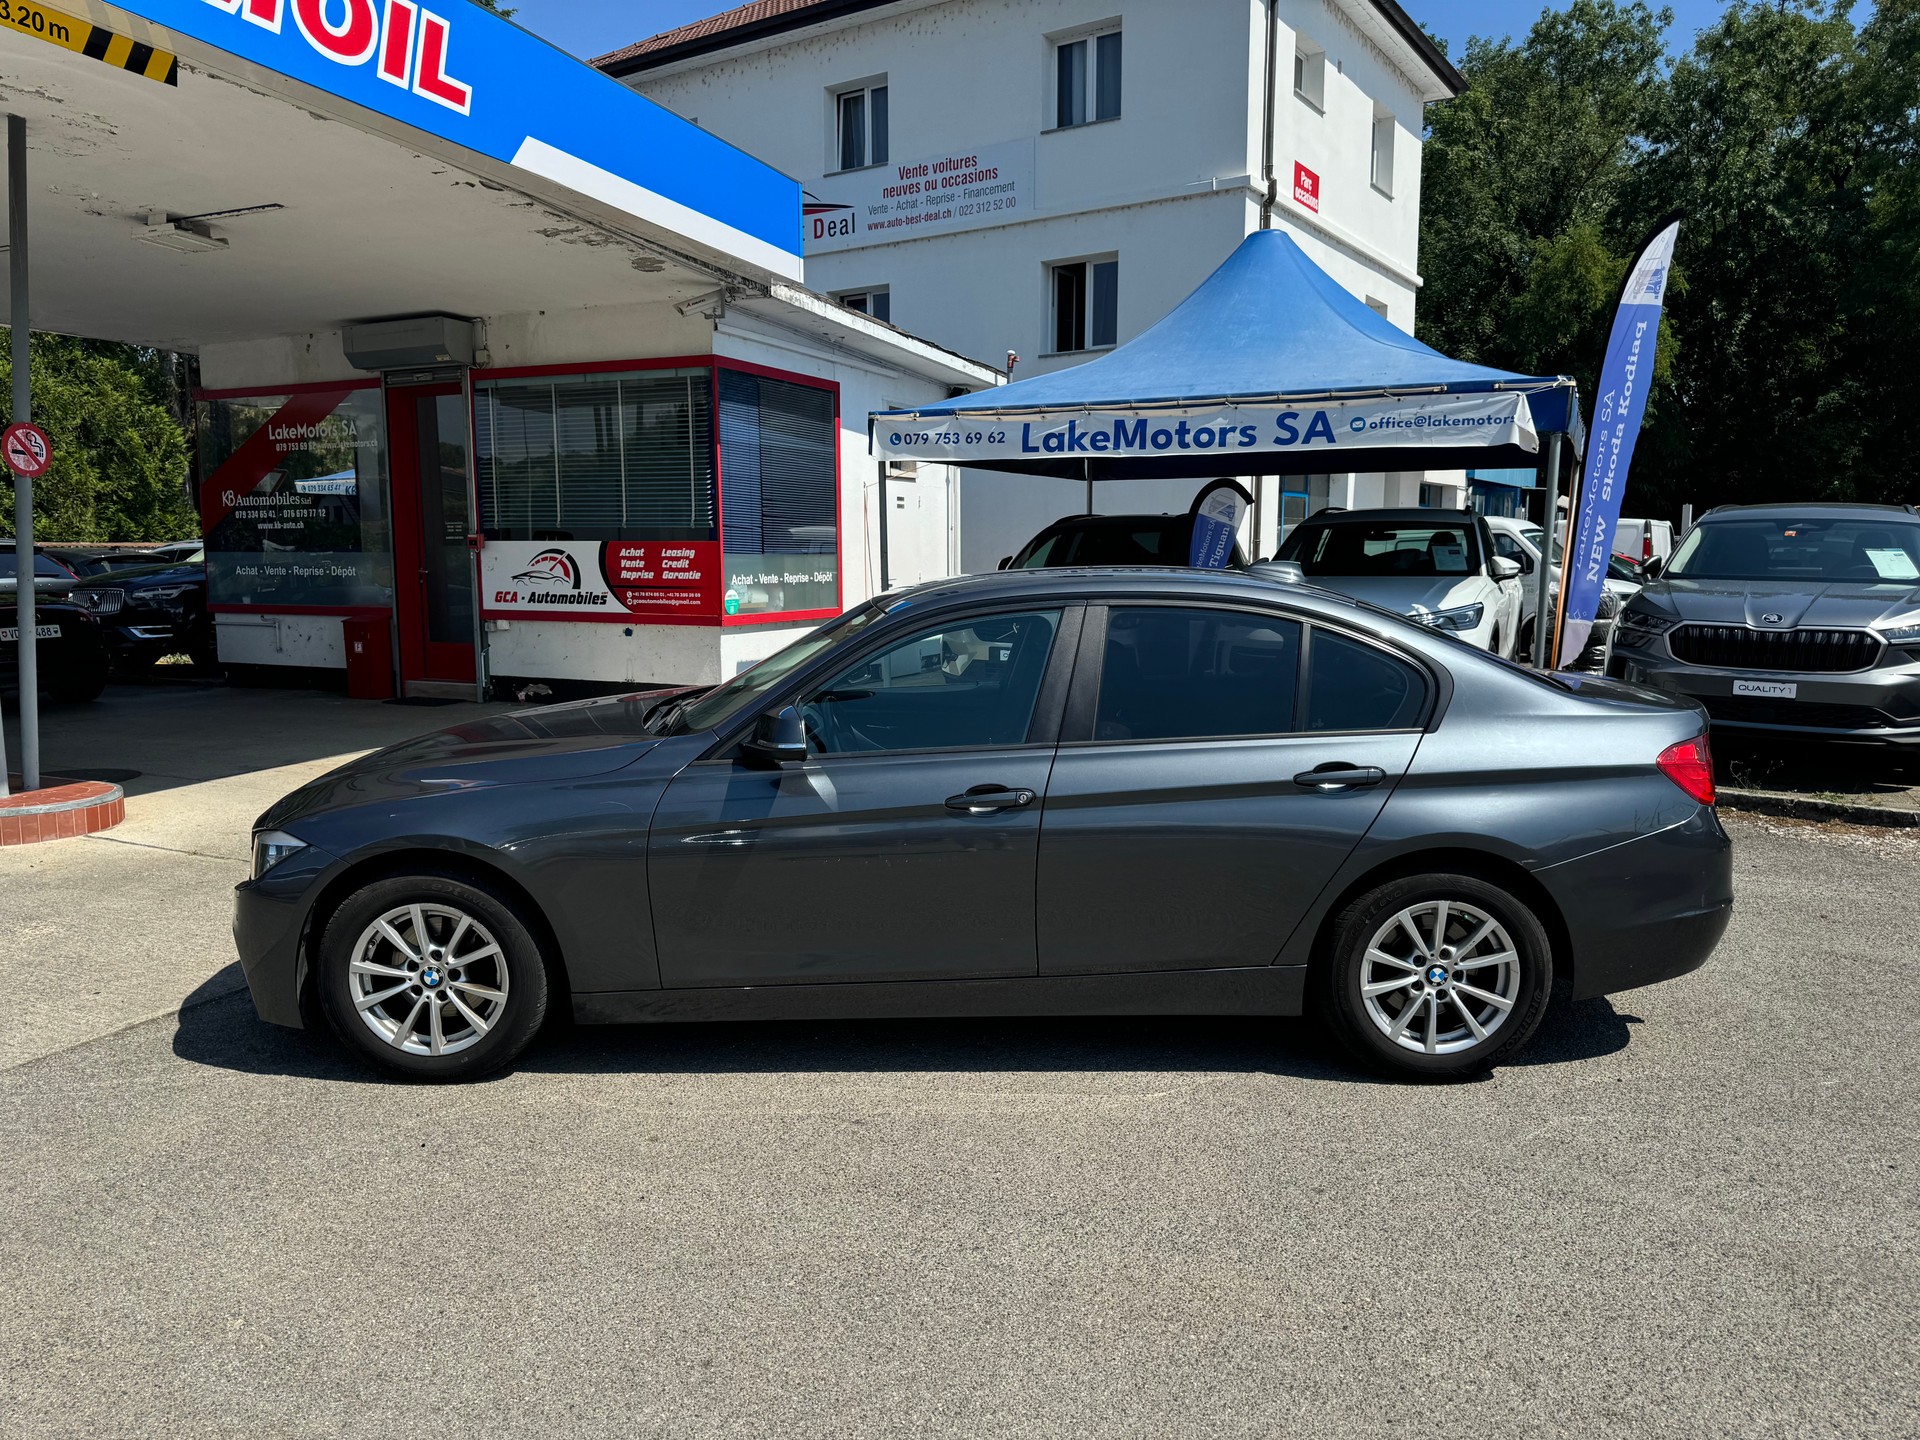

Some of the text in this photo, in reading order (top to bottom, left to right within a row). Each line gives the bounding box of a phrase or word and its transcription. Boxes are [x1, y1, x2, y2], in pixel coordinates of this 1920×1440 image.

[49, 21, 69, 42] m
[194, 0, 472, 117] OIL
[898, 155, 977, 180] Vente voitures
[883, 167, 998, 199] neuves ou occasions
[868, 203, 889, 216] Vente
[896, 199, 918, 211] Achat
[926, 192, 955, 207] Reprise
[963, 181, 1015, 199] Financement
[867, 208, 952, 231] www.auto-best-deal.ch
[959, 204, 974, 217] 022
[975, 202, 991, 214] 312
[993, 199, 1003, 211] 52
[1005, 196, 1016, 209] 00
[813, 212, 856, 240] Deal
[268, 419, 357, 440] LakeMotors SA
[904, 432, 929, 446] 079
[934, 431, 960, 445] 753
[965, 431, 983, 444] 69
[987, 430, 1006, 444] 62
[1021, 417, 1257, 453] LakeMotors
[1273, 410, 1336, 446] SA
[288, 442, 299, 451] 753
[1586, 321, 1647, 583] NEW Skoda Kodiaq
[1576, 389, 1615, 571] LakeMotors SA
[235, 510, 246, 519] 079
[247, 510, 258, 519] 334
[259, 510, 267, 519] 65
[268, 510, 276, 518] 41
[283, 509, 295, 518] 076
[309, 508, 317, 517] 77
[318, 508, 326, 517] 12
[620, 547, 695, 559] Achat Leasing
[1208, 527, 1230, 567] Tiguan
[235, 565, 258, 576] Achat
[264, 565, 287, 576] Vente
[293, 565, 324, 578] Reprise
[331, 564, 356, 578] Dépôt
[621, 559, 645, 568] Vente
[620, 570, 701, 580] Reprise Garantie
[731, 573, 753, 585] Achat
[758, 573, 779, 584] Vente
[783, 572, 809, 585] Reprise
[814, 571, 832, 584] Dépôt
[494, 591, 607, 605] GCA Automobiles
[1738, 684, 1786, 694] QUALITY
